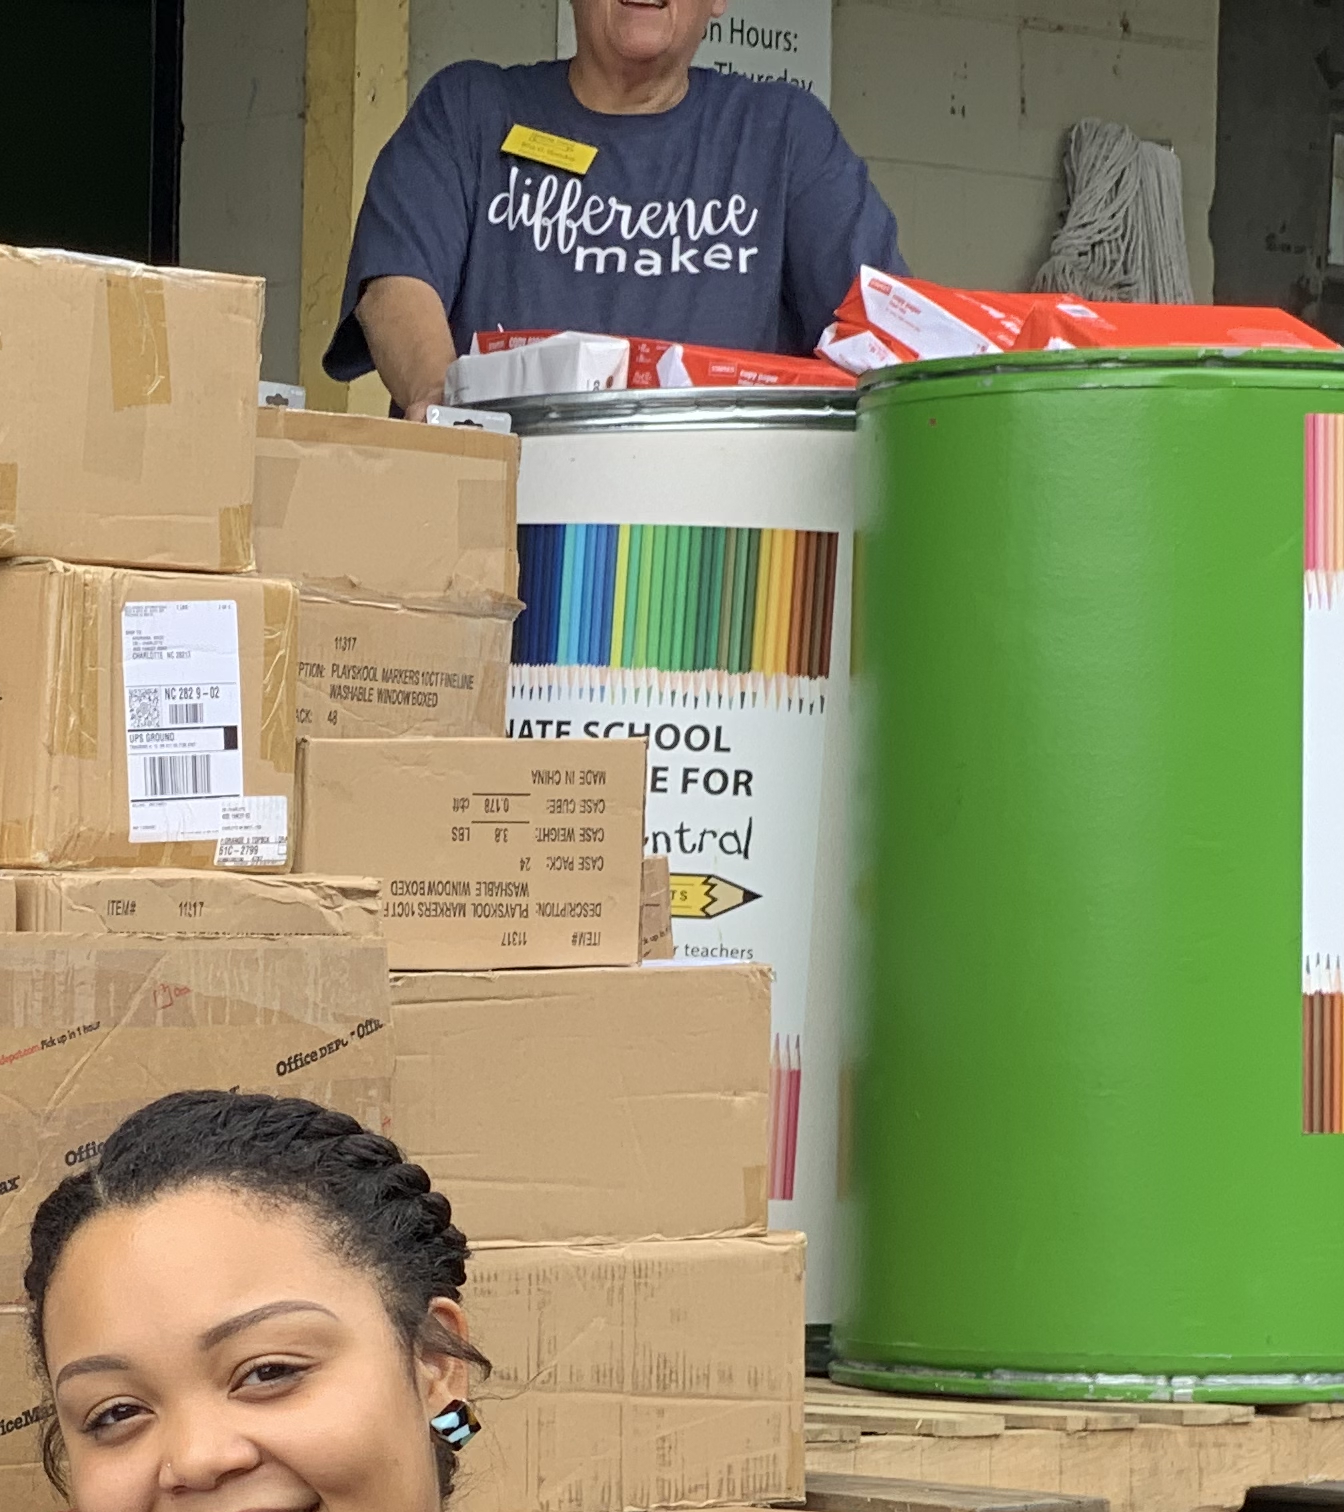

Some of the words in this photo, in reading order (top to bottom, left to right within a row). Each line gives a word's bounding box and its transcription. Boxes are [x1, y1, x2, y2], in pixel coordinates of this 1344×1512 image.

[730, 17, 798, 53] Hours:
[488, 166, 758, 254] difference
[575, 235, 758, 276] maker
[334, 637, 357, 651] 11317
[331, 664, 378, 682] PLAYSKOOL
[382, 668, 420, 685] MARKERS
[165, 688, 176, 700] NC
[330, 684, 374, 702] WASHABLE
[327, 710, 338, 725] 48
[583, 721, 731, 752] SCHOOL
[531, 770, 562, 785] CHINA
[565, 770, 575, 785] IN
[579, 770, 606, 785] MADE
[681, 767, 754, 796] FOR
[484, 798, 510, 813] 0.178
[546, 799, 576, 813] CUBE:
[579, 799, 605, 813] CASE
[451, 827, 470, 841] LBS
[535, 828, 575, 842] WEIGHT:
[578, 828, 604, 842] CASE
[644, 816, 753, 859] ntral
[519, 857, 531, 871] 24
[546, 856, 574, 871] PACK:
[578, 856, 604, 871] CASE
[391, 881, 425, 896] BOXED
[428, 882, 471, 896] WINDOW
[475, 882, 530, 897] WASHABLE
[107, 900, 137, 916] ITEM#
[391, 902, 415, 917] 10CT
[417, 902, 466, 917] MARKERS
[472, 903, 529, 918] PLAYSKOOL
[536, 903, 602, 918] DESCRIPTION:
[501, 932, 527, 946] 11317
[571, 932, 600, 946] ITEM#
[684, 944, 754, 959] teachers
[276, 1050, 318, 1077] Office
